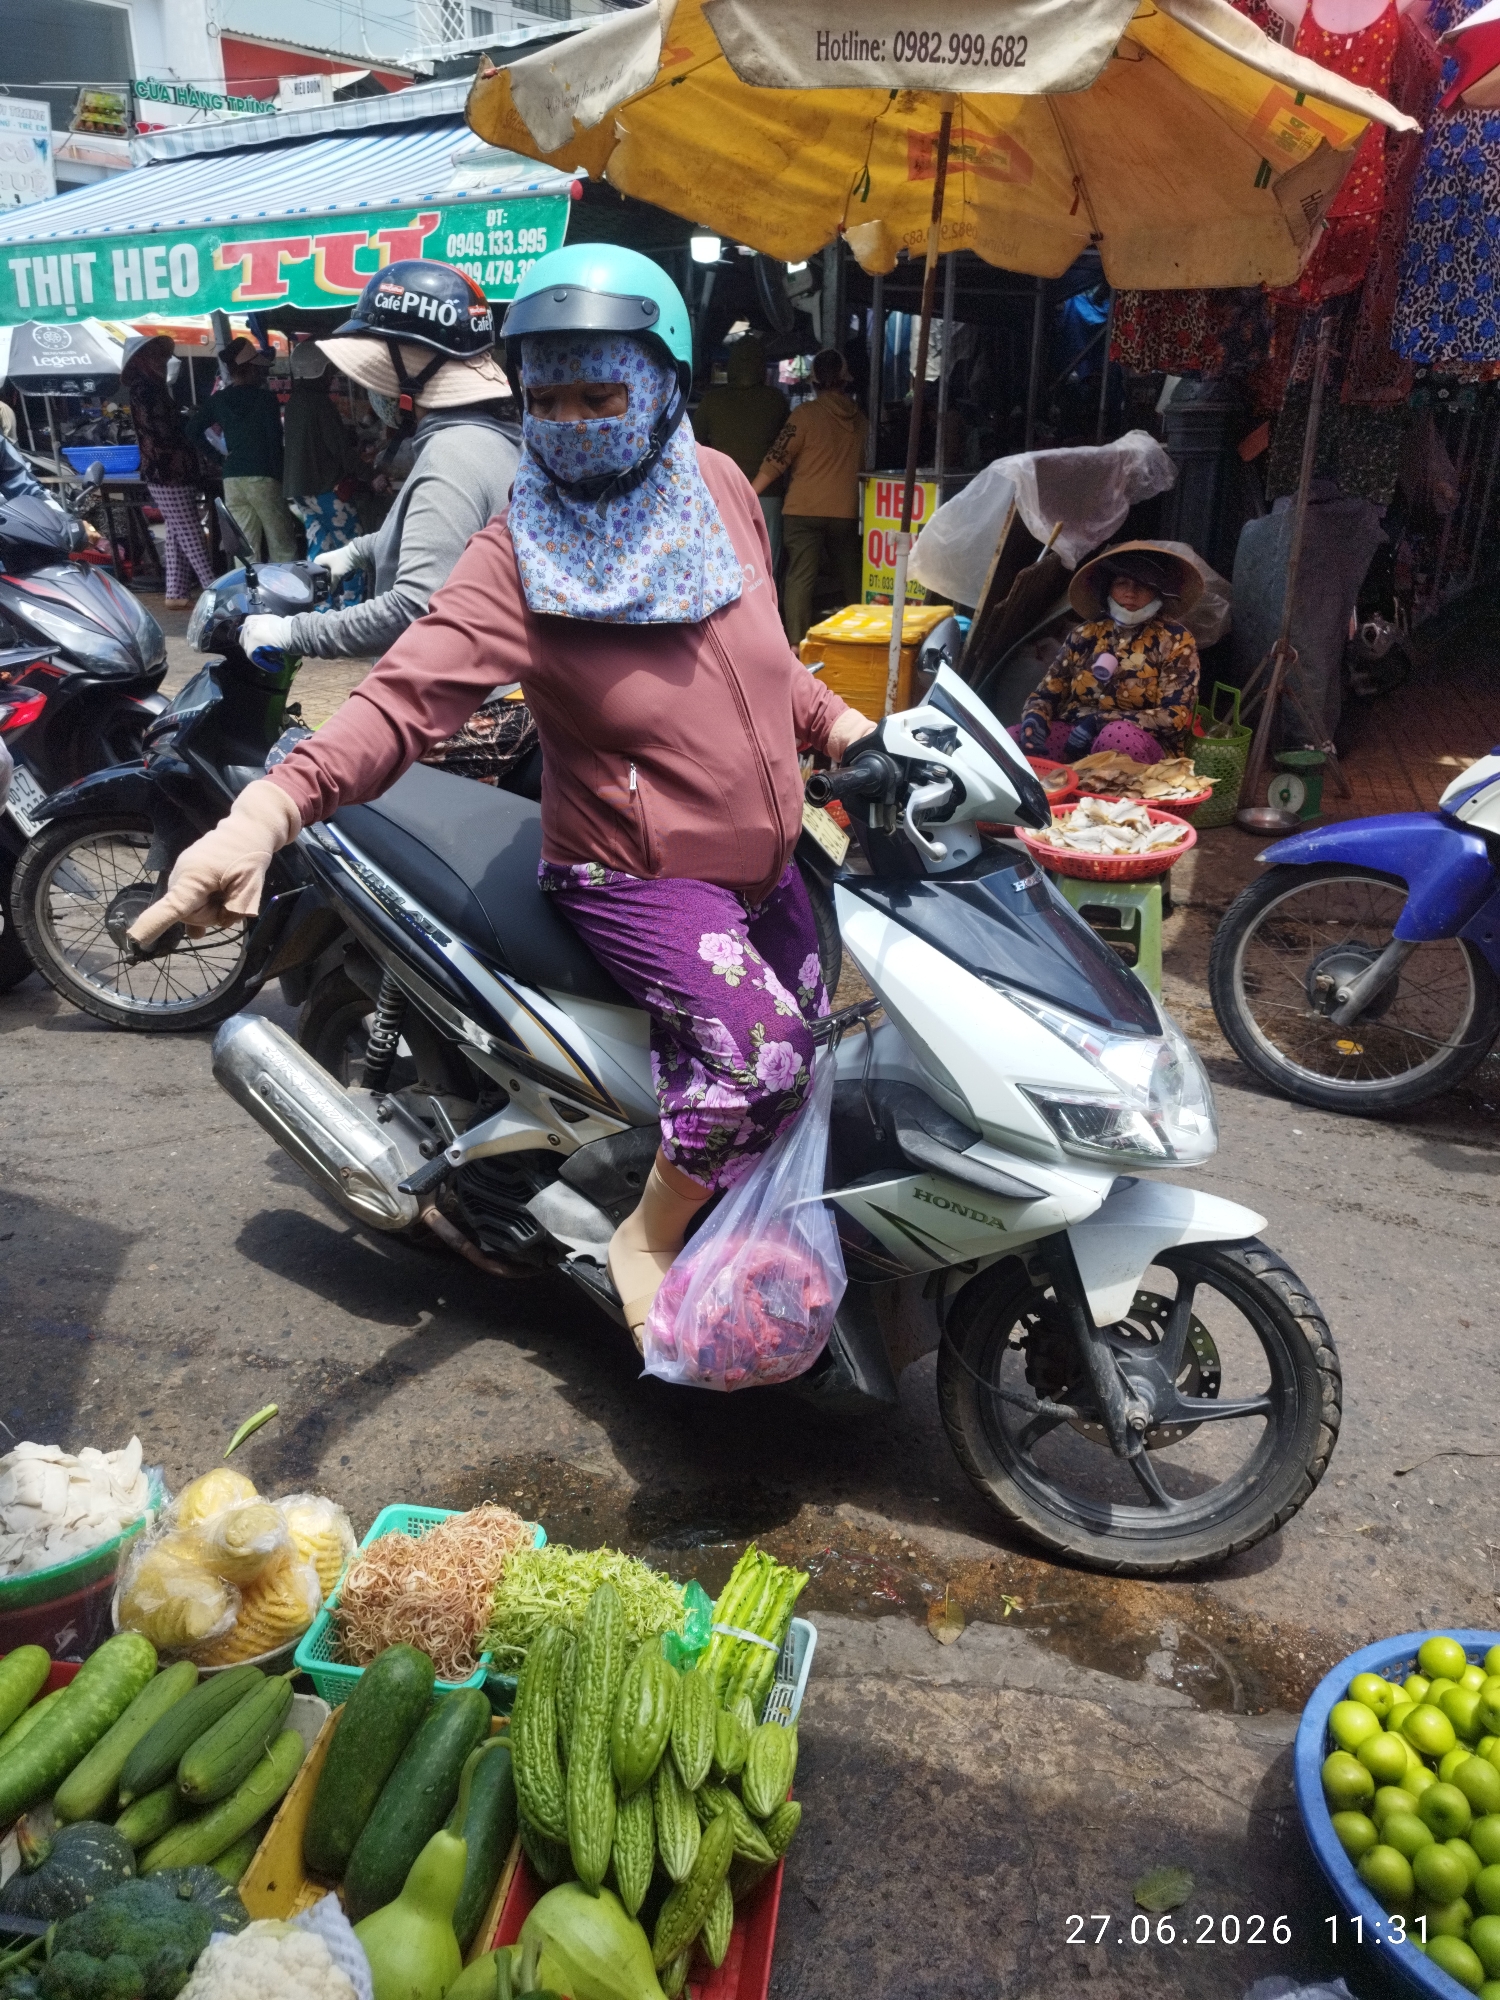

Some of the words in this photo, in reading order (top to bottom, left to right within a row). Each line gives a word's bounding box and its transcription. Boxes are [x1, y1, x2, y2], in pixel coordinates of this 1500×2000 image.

[816, 30, 887, 62] Hotline:
[893, 31, 1028, 67] 0982.999.682
[135, 76, 171, 102] CỬA
[175, 83, 223, 111] HÀNG
[9, 105, 46, 122] TRANG
[486, 208, 508, 227] ĐT:
[446, 227, 548, 258] 0949.133.995
[8, 252, 97, 317] THỊT
[112, 243, 200, 302] HEO
[213, 210, 441, 302] TƯ
[374, 293, 403, 311] Café
[32, 353, 92, 368] Legend
[912, 1186, 1008, 1232] HONDA
